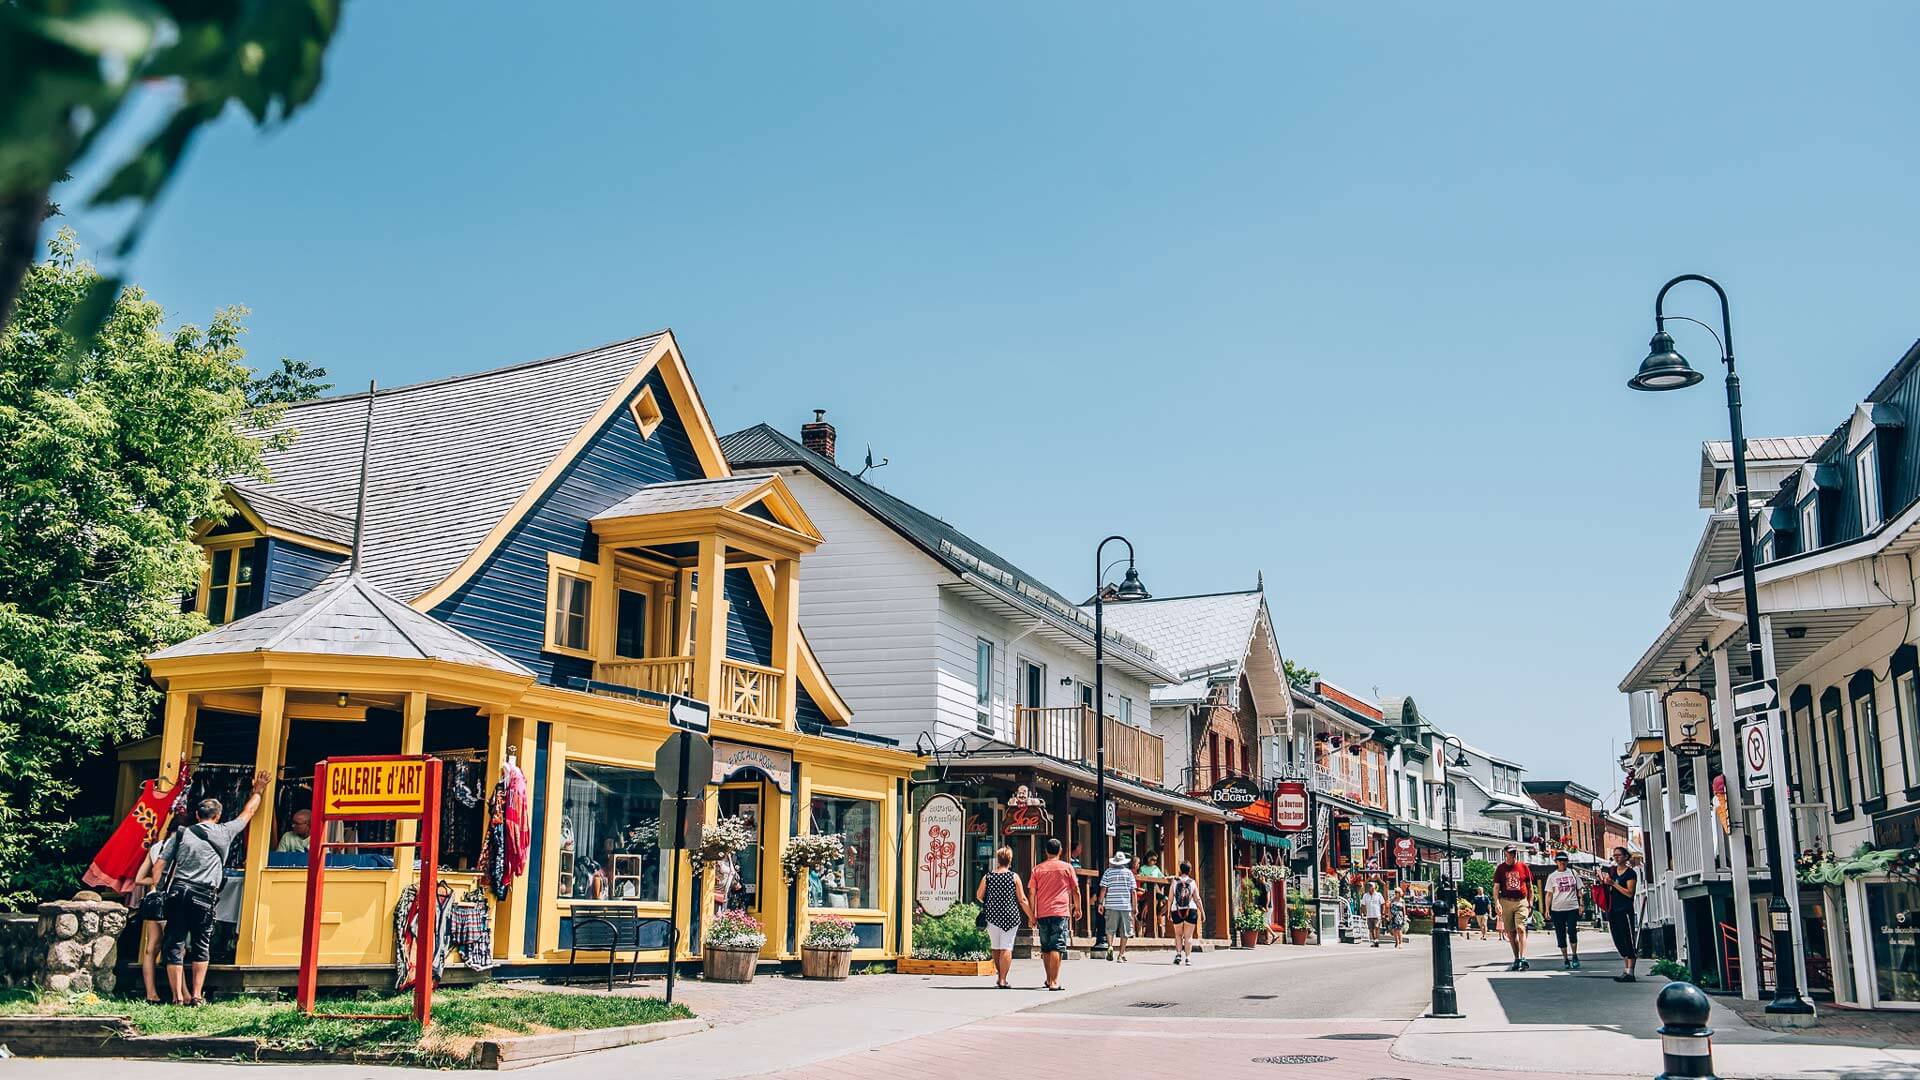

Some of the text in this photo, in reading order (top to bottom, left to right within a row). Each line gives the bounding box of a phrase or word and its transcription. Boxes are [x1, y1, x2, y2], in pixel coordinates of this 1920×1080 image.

[1677, 711, 1697, 720] Village
[332, 765, 422, 796] GALERIE d'ART
